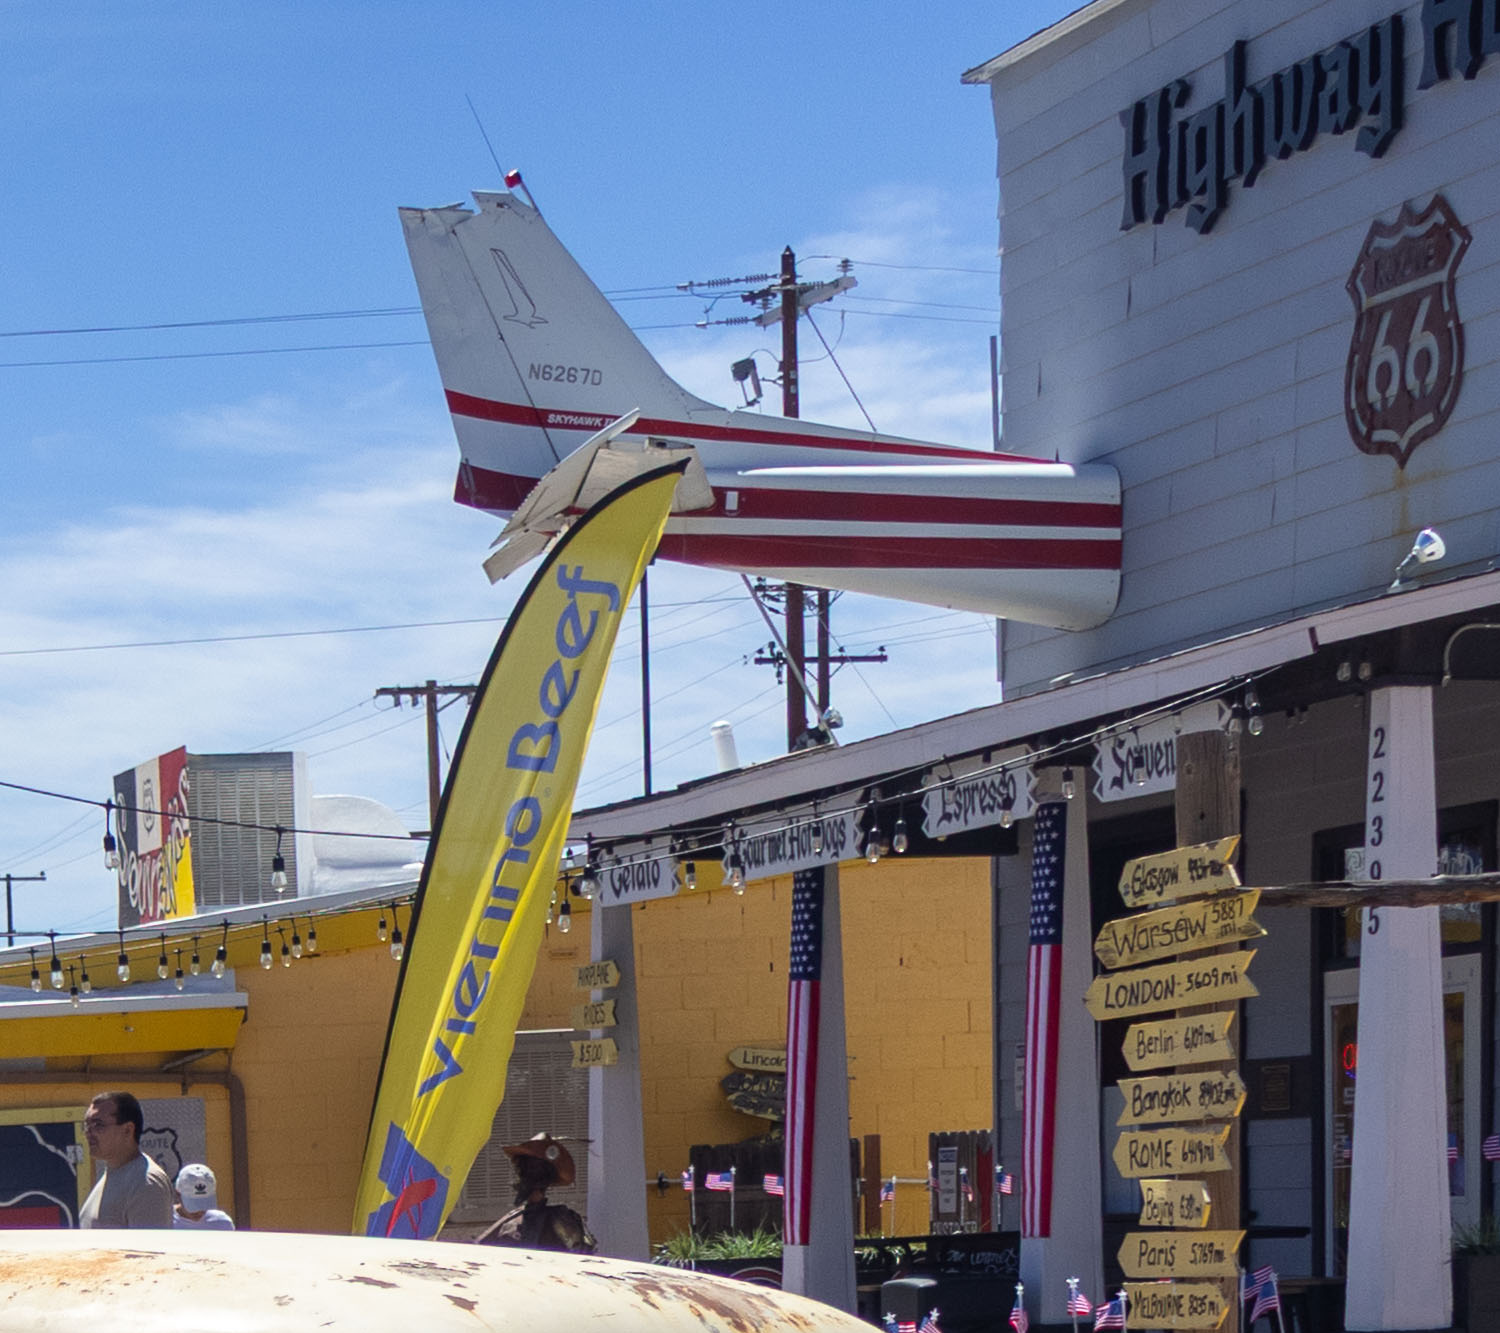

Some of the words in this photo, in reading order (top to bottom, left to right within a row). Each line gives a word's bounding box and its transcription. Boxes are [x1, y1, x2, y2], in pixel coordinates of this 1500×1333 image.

[1119, 14, 1404, 234] Highway
[1366, 295, 1440, 413] 66
[528, 363, 603, 386] N6267D
[547, 413, 603, 427] SKYHAWK
[937, 771, 1017, 829] Espresso
[417, 795, 542, 1099] Vienna
[506, 563, 620, 775] Beef
[786, 817, 813, 862] Hot
[609, 854, 661, 899] Gelato
[1131, 863, 1179, 898] Glasgow
[1112, 911, 1207, 957] Warsaw
[1211, 897, 1244, 924] 5887
[577, 963, 611, 987] AIRPLANE
[583, 1002, 606, 1020] RIDES
[1136, 1029, 1174, 1060] Berlin
[1131, 1082, 1191, 1118] Bangkok
[1129, 1138, 1173, 1170] ROME
[1138, 1240, 1176, 1267] Paris
